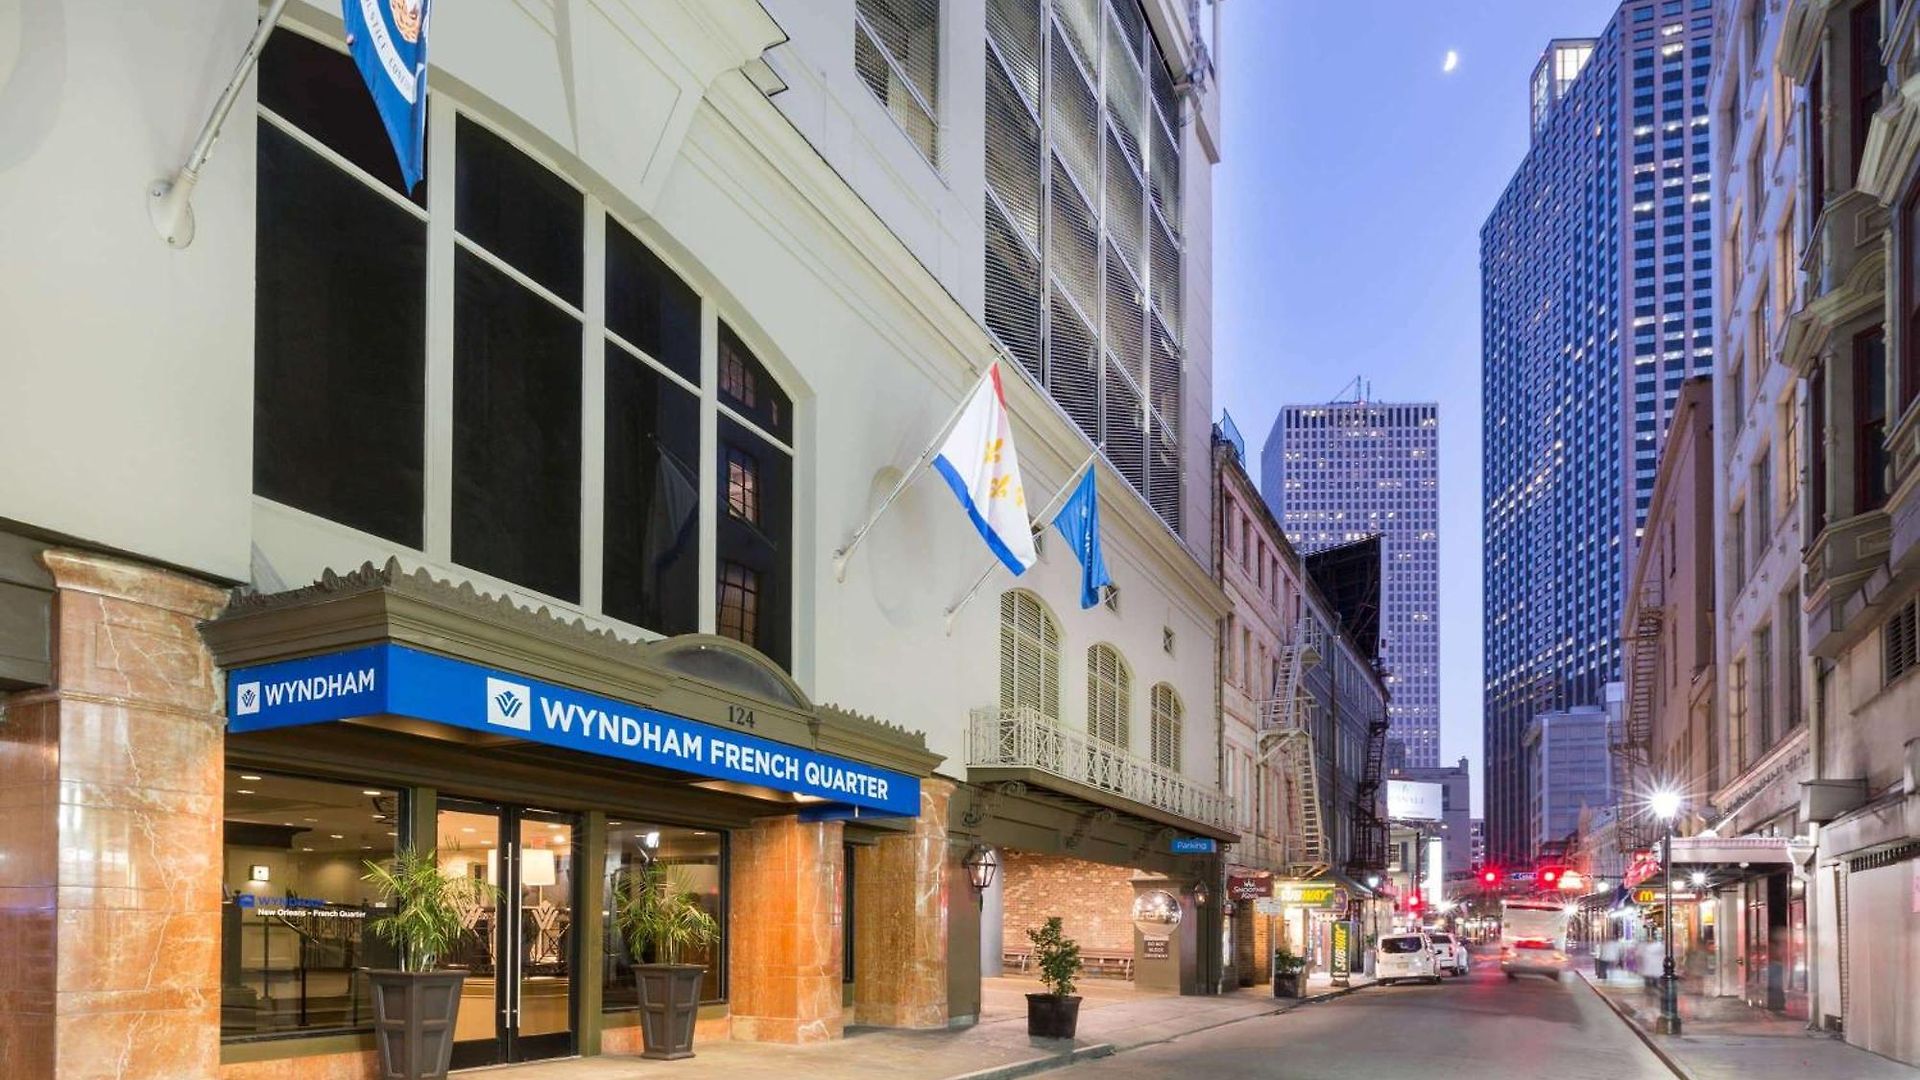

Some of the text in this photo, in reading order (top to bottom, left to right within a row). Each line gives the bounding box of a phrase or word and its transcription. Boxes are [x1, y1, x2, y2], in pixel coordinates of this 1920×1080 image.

[264, 668, 375, 707] WYNDHAM
[728, 705, 755, 729] 124
[539, 696, 889, 800] WYNDHAM FRENCH QUARTER
[1177, 841, 1207, 851] Parking
[1280, 889, 1333, 902] SUBWAY
[257, 908, 275, 917] New
[278, 908, 306, 918] Orleans
[313, 908, 339, 918] French
[339, 909, 366, 919] Quarter
[1334, 923, 1347, 971] SUBWAY
